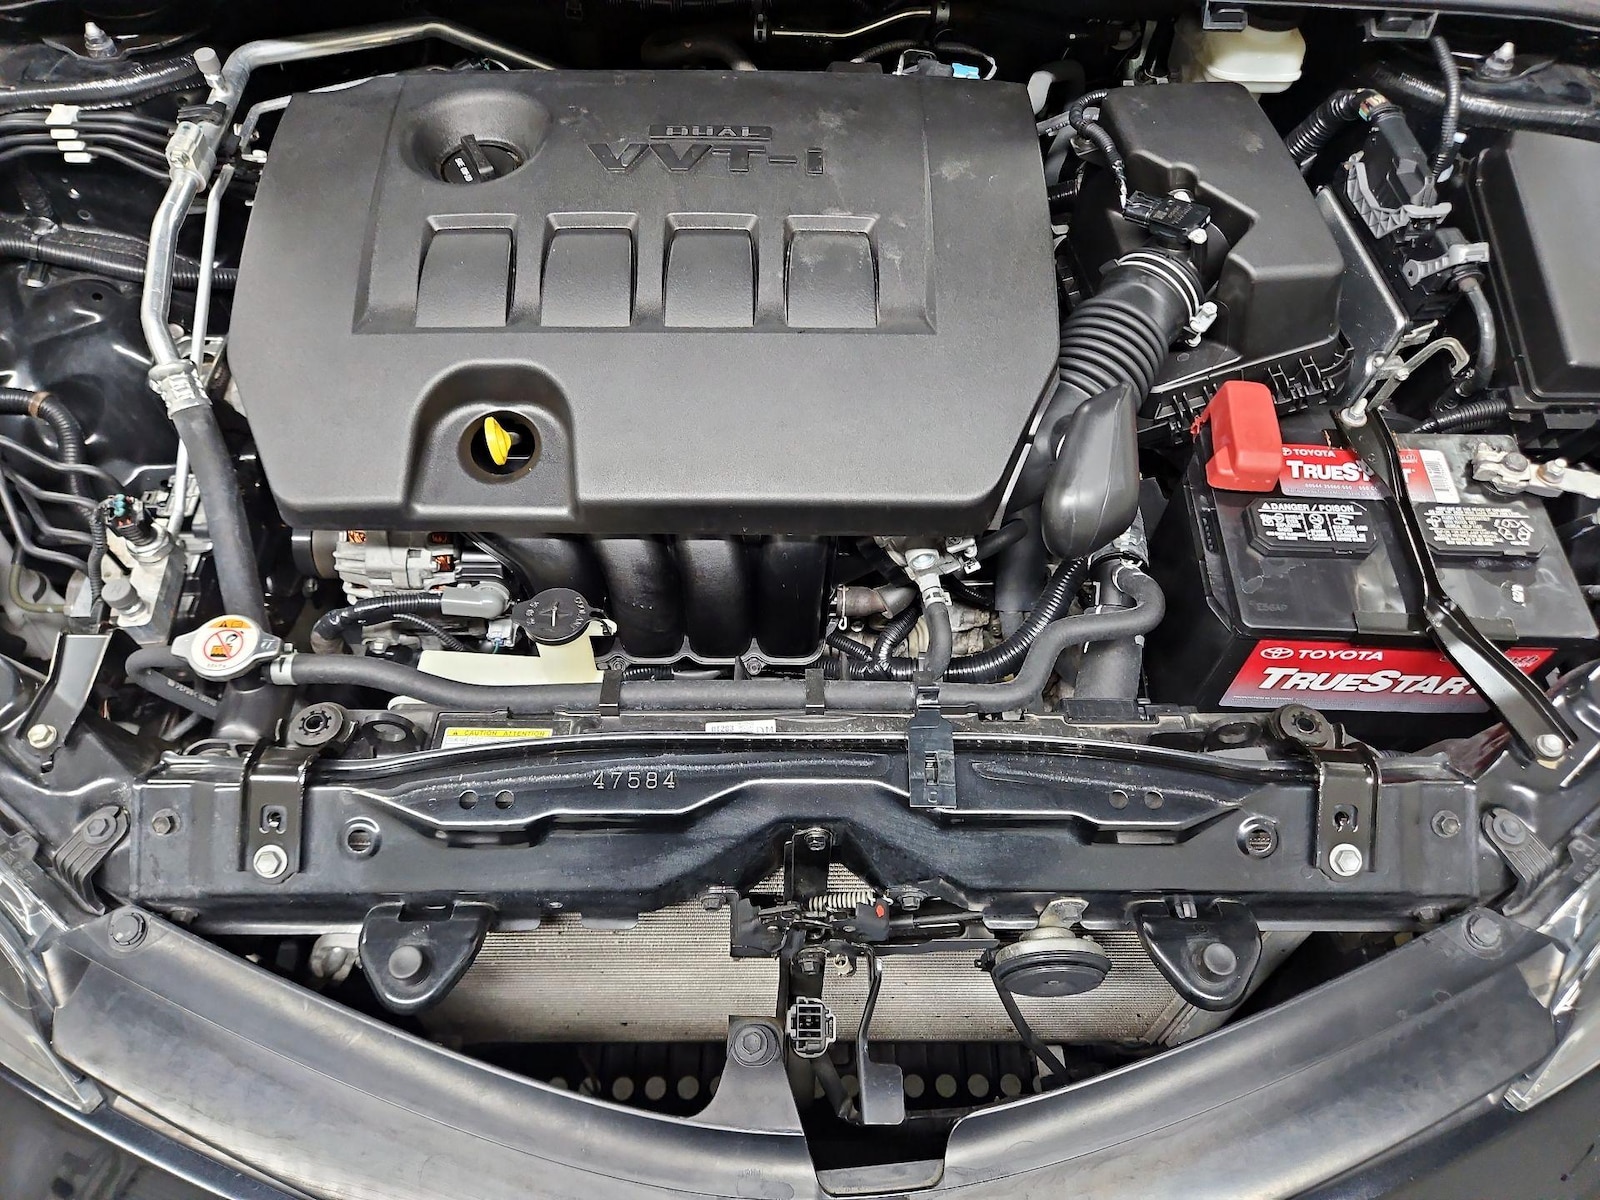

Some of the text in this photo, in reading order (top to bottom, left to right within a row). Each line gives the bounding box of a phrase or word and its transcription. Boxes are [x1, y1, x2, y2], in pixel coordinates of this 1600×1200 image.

[666, 125, 762, 137] DUAL
[587, 143, 824, 175] VVT-i
[1293, 448, 1336, 458] TOYOTA
[1270, 503, 1310, 512] DANGER
[1318, 504, 1354, 512] POISON
[1298, 650, 1383, 661] TOYOTA
[1258, 667, 1477, 695] TRUESTAR
[592, 770, 676, 789] 47584
